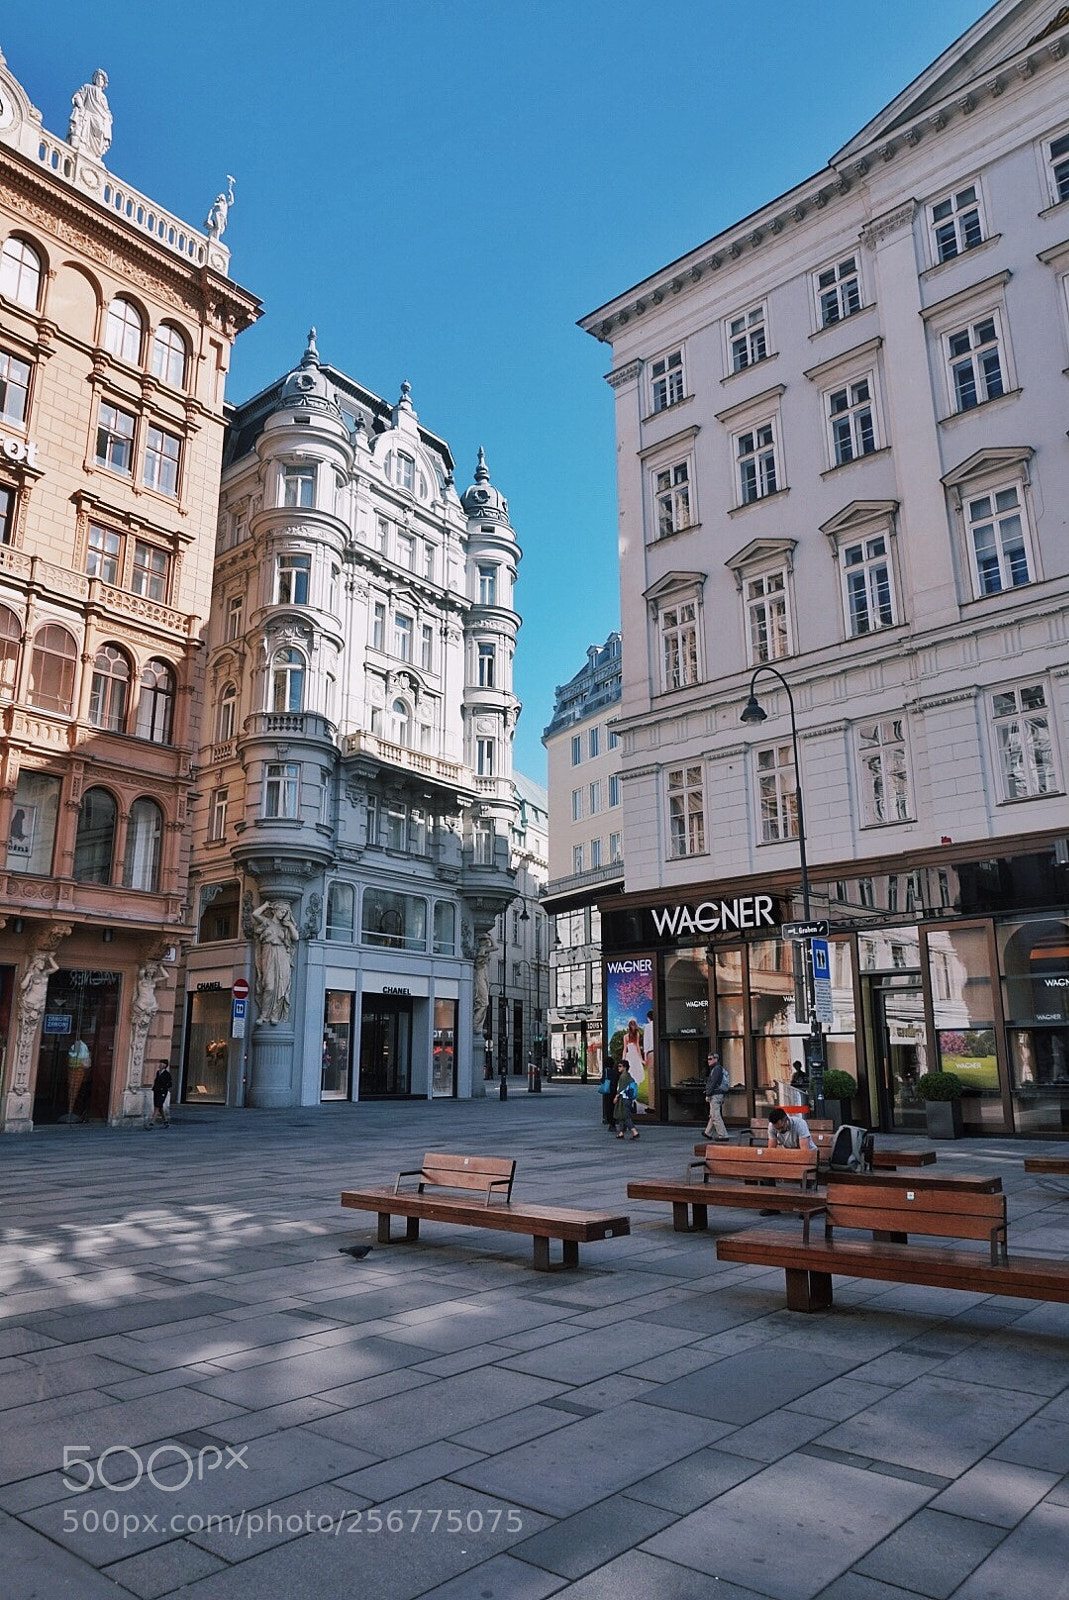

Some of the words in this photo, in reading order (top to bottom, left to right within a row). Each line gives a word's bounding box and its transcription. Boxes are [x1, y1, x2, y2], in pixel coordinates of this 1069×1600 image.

[650, 895, 776, 937] WAGNER
[607, 958, 653, 974] WAGNER
[197, 981, 222, 991] CHANEL
[382, 986, 412, 996] CHANEL
[685, 1000, 709, 1008] WAGNER
[955, 1062, 982, 1070] WAGNER
